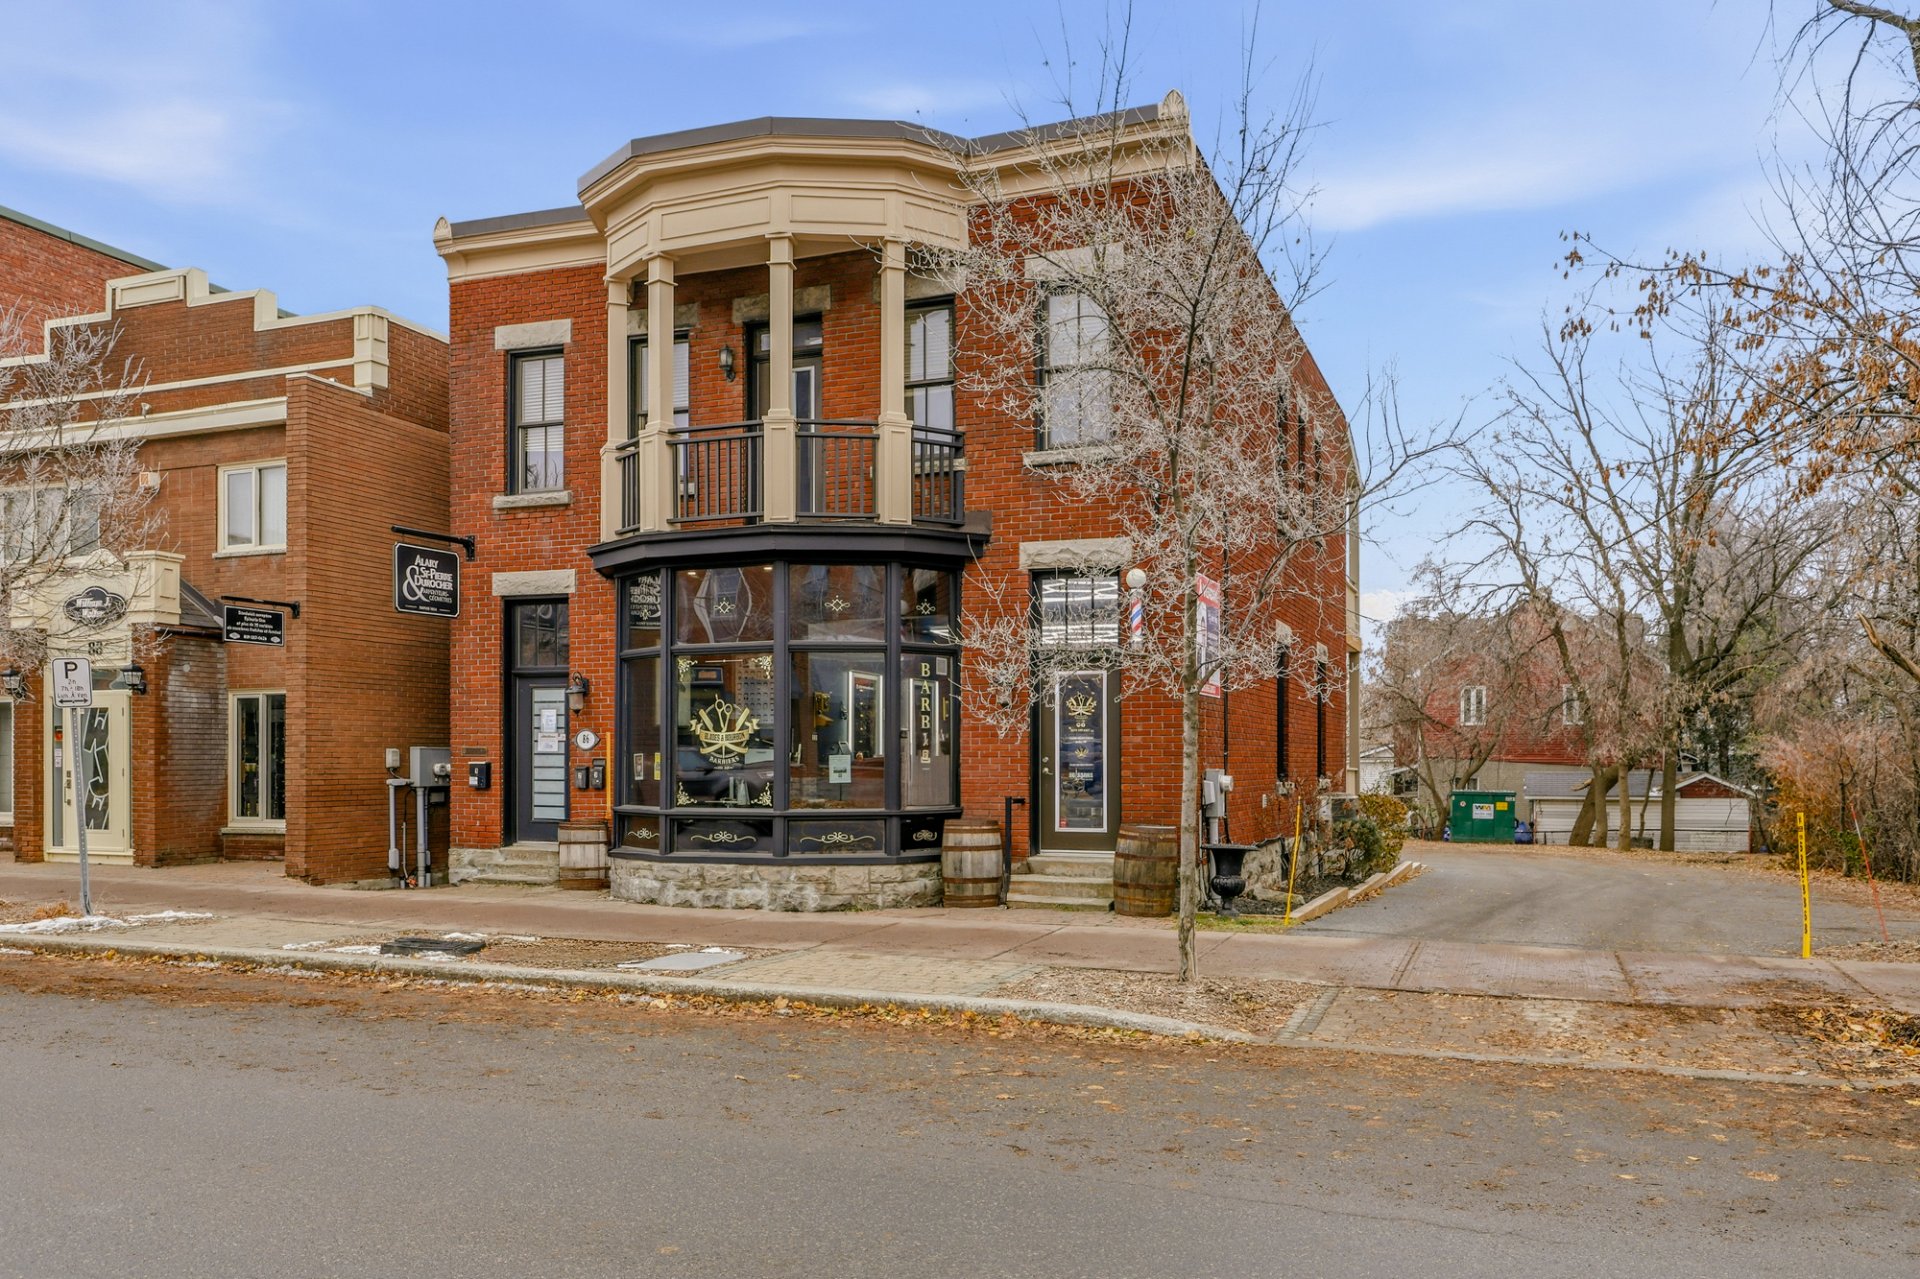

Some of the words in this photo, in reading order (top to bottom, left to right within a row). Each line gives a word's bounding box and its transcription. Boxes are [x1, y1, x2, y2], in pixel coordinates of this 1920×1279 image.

[414, 554, 439, 569] ALARY
[414, 575, 453, 590] DUROCHER
[64, 661, 78, 679] P
